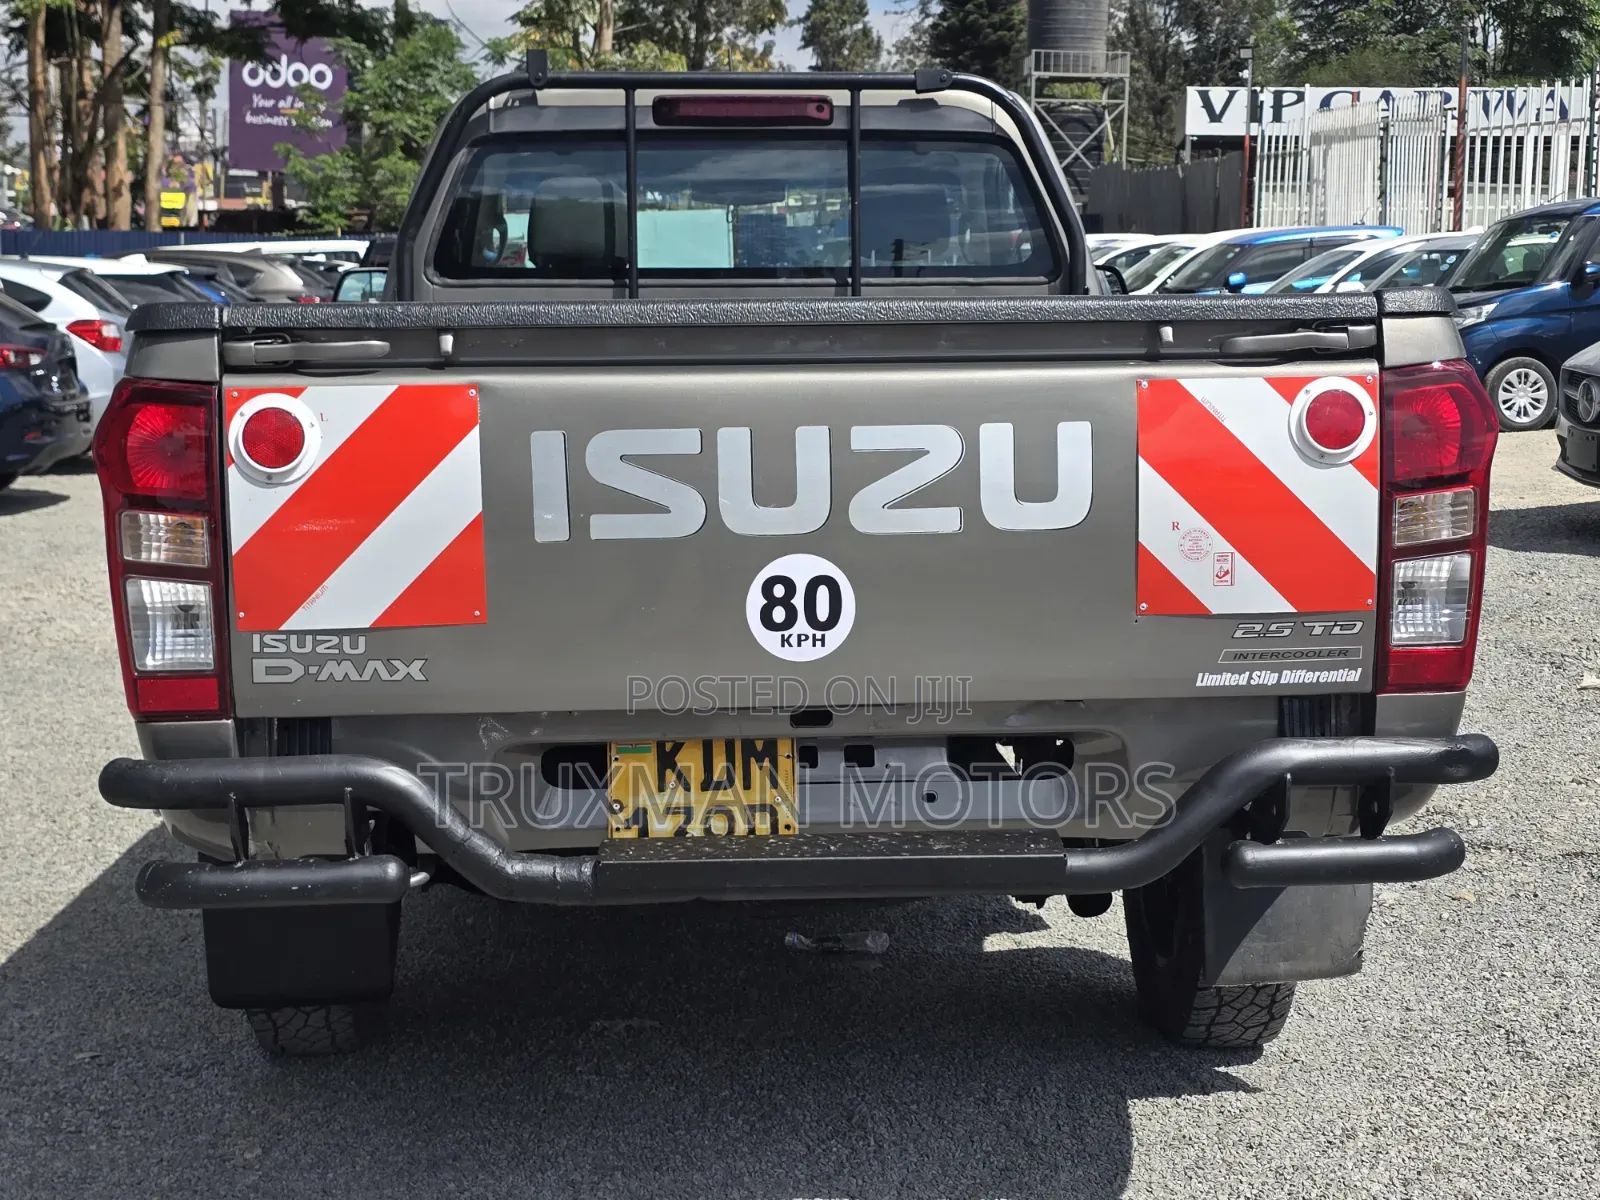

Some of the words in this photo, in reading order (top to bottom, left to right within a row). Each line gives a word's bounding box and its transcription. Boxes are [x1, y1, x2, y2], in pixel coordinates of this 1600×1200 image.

[242, 53, 333, 90] odoo
[252, 93, 276, 109] Your
[278, 95, 294, 109] all
[245, 110, 289, 126] business
[1200, 395, 1227, 423] TITANIUM
[530, 421, 1093, 543] ISUZU
[1171, 521, 1181, 531] R
[301, 584, 329, 612] TITANIUM
[759, 574, 843, 632] 80
[1231, 621, 1296, 638] 2.5
[1301, 620, 1364, 636] TD
[251, 633, 367, 655] ISUZU
[780, 633, 826, 648] KPH
[1232, 649, 1349, 661] INTERCOOLER
[252, 658, 428, 684] D-MAX
[1195, 671, 1249, 687] Limited
[1249, 670, 1278, 686] Slip
[1279, 667, 1363, 684] Differential
